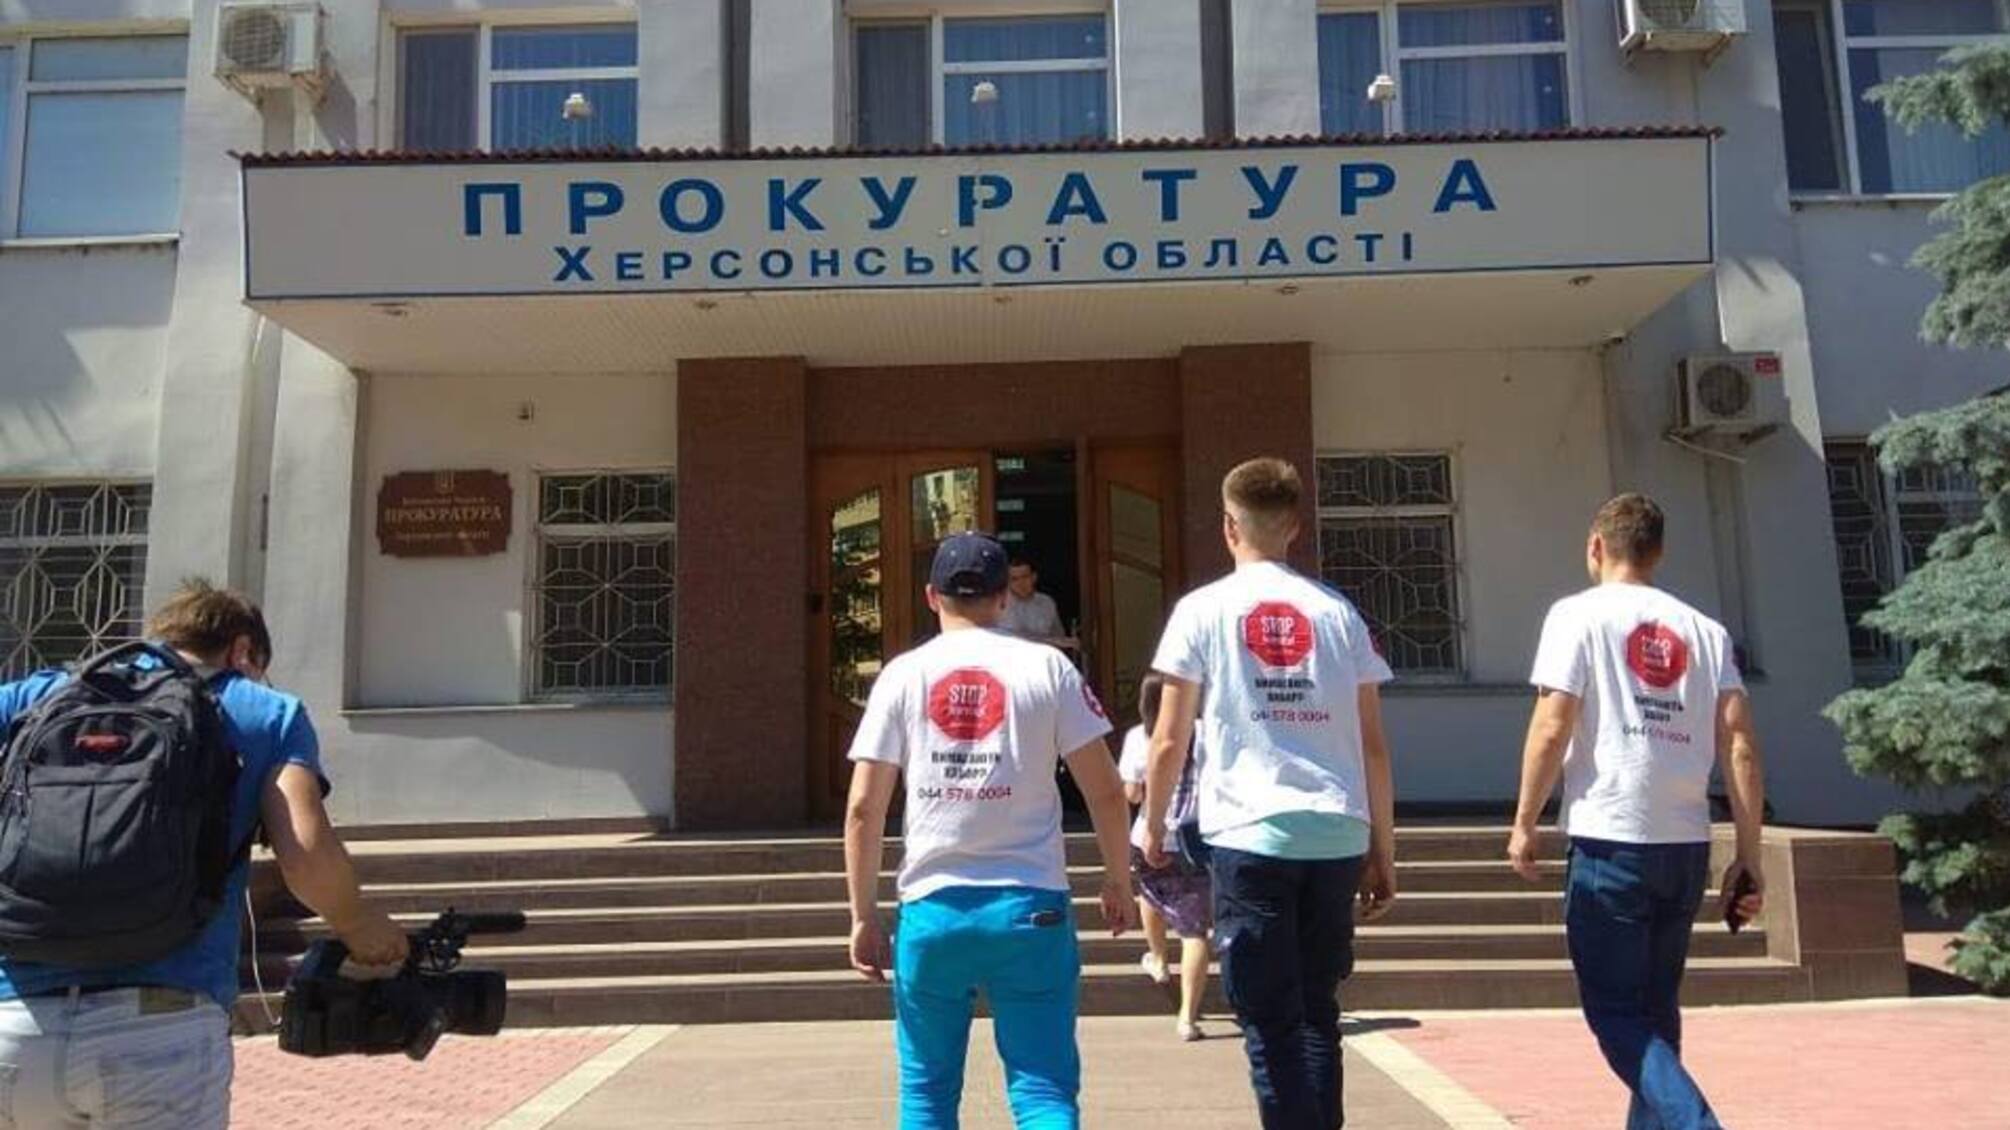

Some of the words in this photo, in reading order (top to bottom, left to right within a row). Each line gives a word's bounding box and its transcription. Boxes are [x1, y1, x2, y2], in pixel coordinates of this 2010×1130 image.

[463, 158, 1498, 237] ПРОКУРАТУРА
[552, 237, 1065, 283] ХЕРСОНСЬКОЇ
[1102, 232, 1414, 270] ОБЛАСТІ
[385, 506, 501, 522] ПРОКУРАТУРА
[1260, 616, 1295, 635] STOP
[949, 684, 988, 705] STOP
[917, 787, 942, 799] 044
